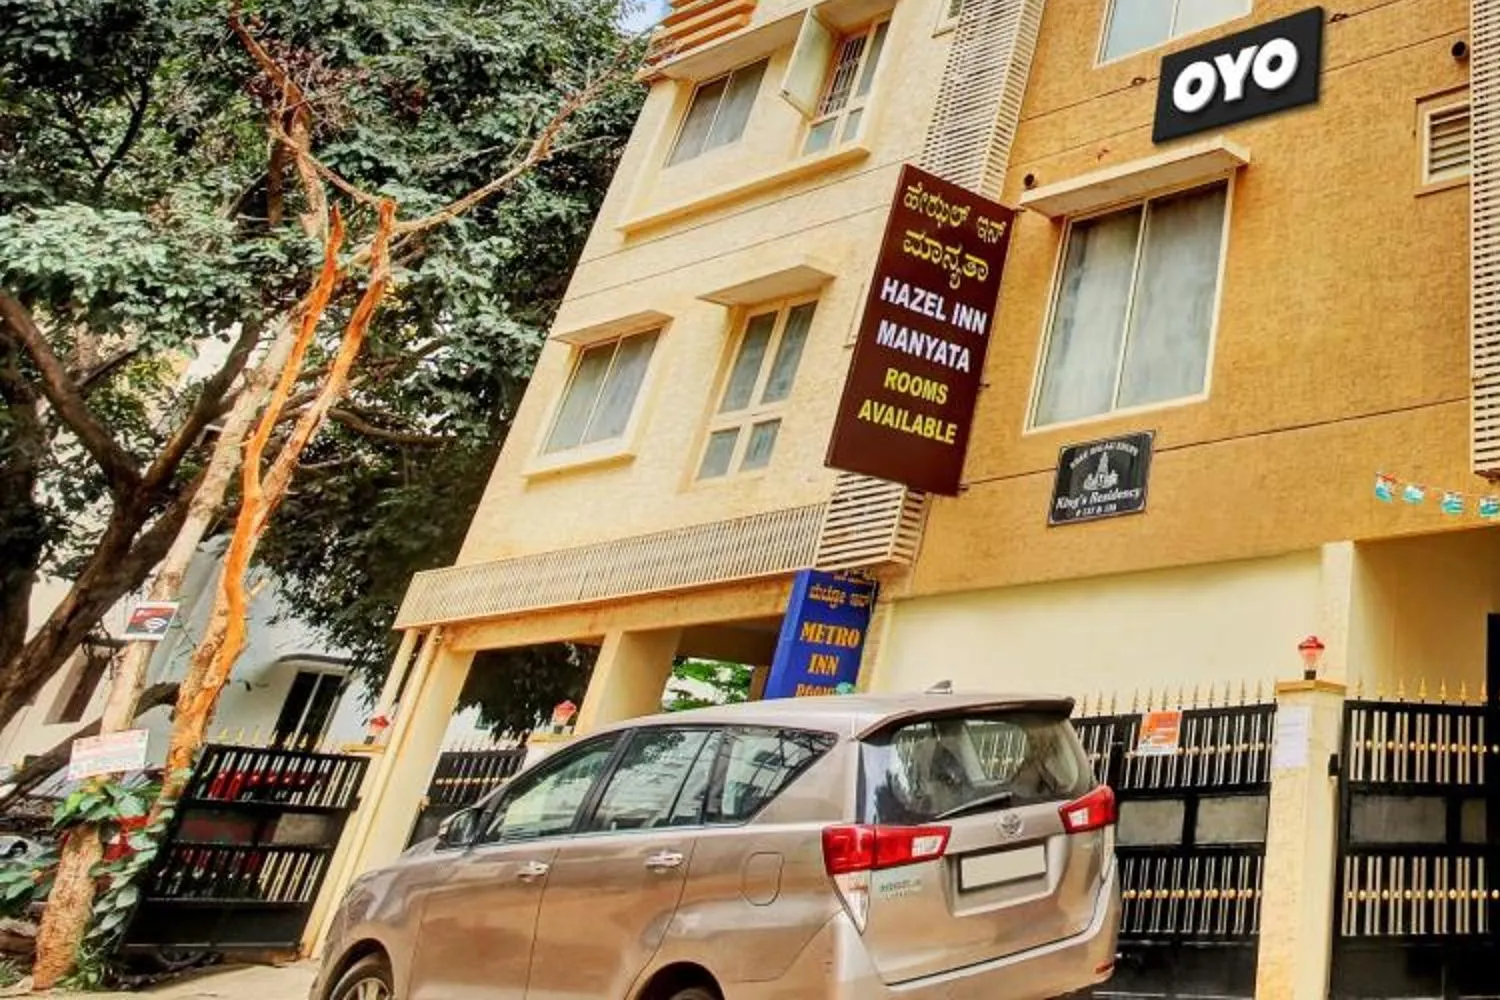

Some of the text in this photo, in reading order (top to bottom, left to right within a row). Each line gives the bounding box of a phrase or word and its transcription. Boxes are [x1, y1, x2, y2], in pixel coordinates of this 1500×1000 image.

[1173, 38, 1298, 113] OYO
[881, 277, 987, 336] HAZEL INN
[876, 319, 971, 373] MANYATA
[884, 367, 949, 405] ROOMS
[857, 399, 957, 445] AVAILABLE
[801, 622, 860, 648] METRO
[808, 653, 839, 676] INN
